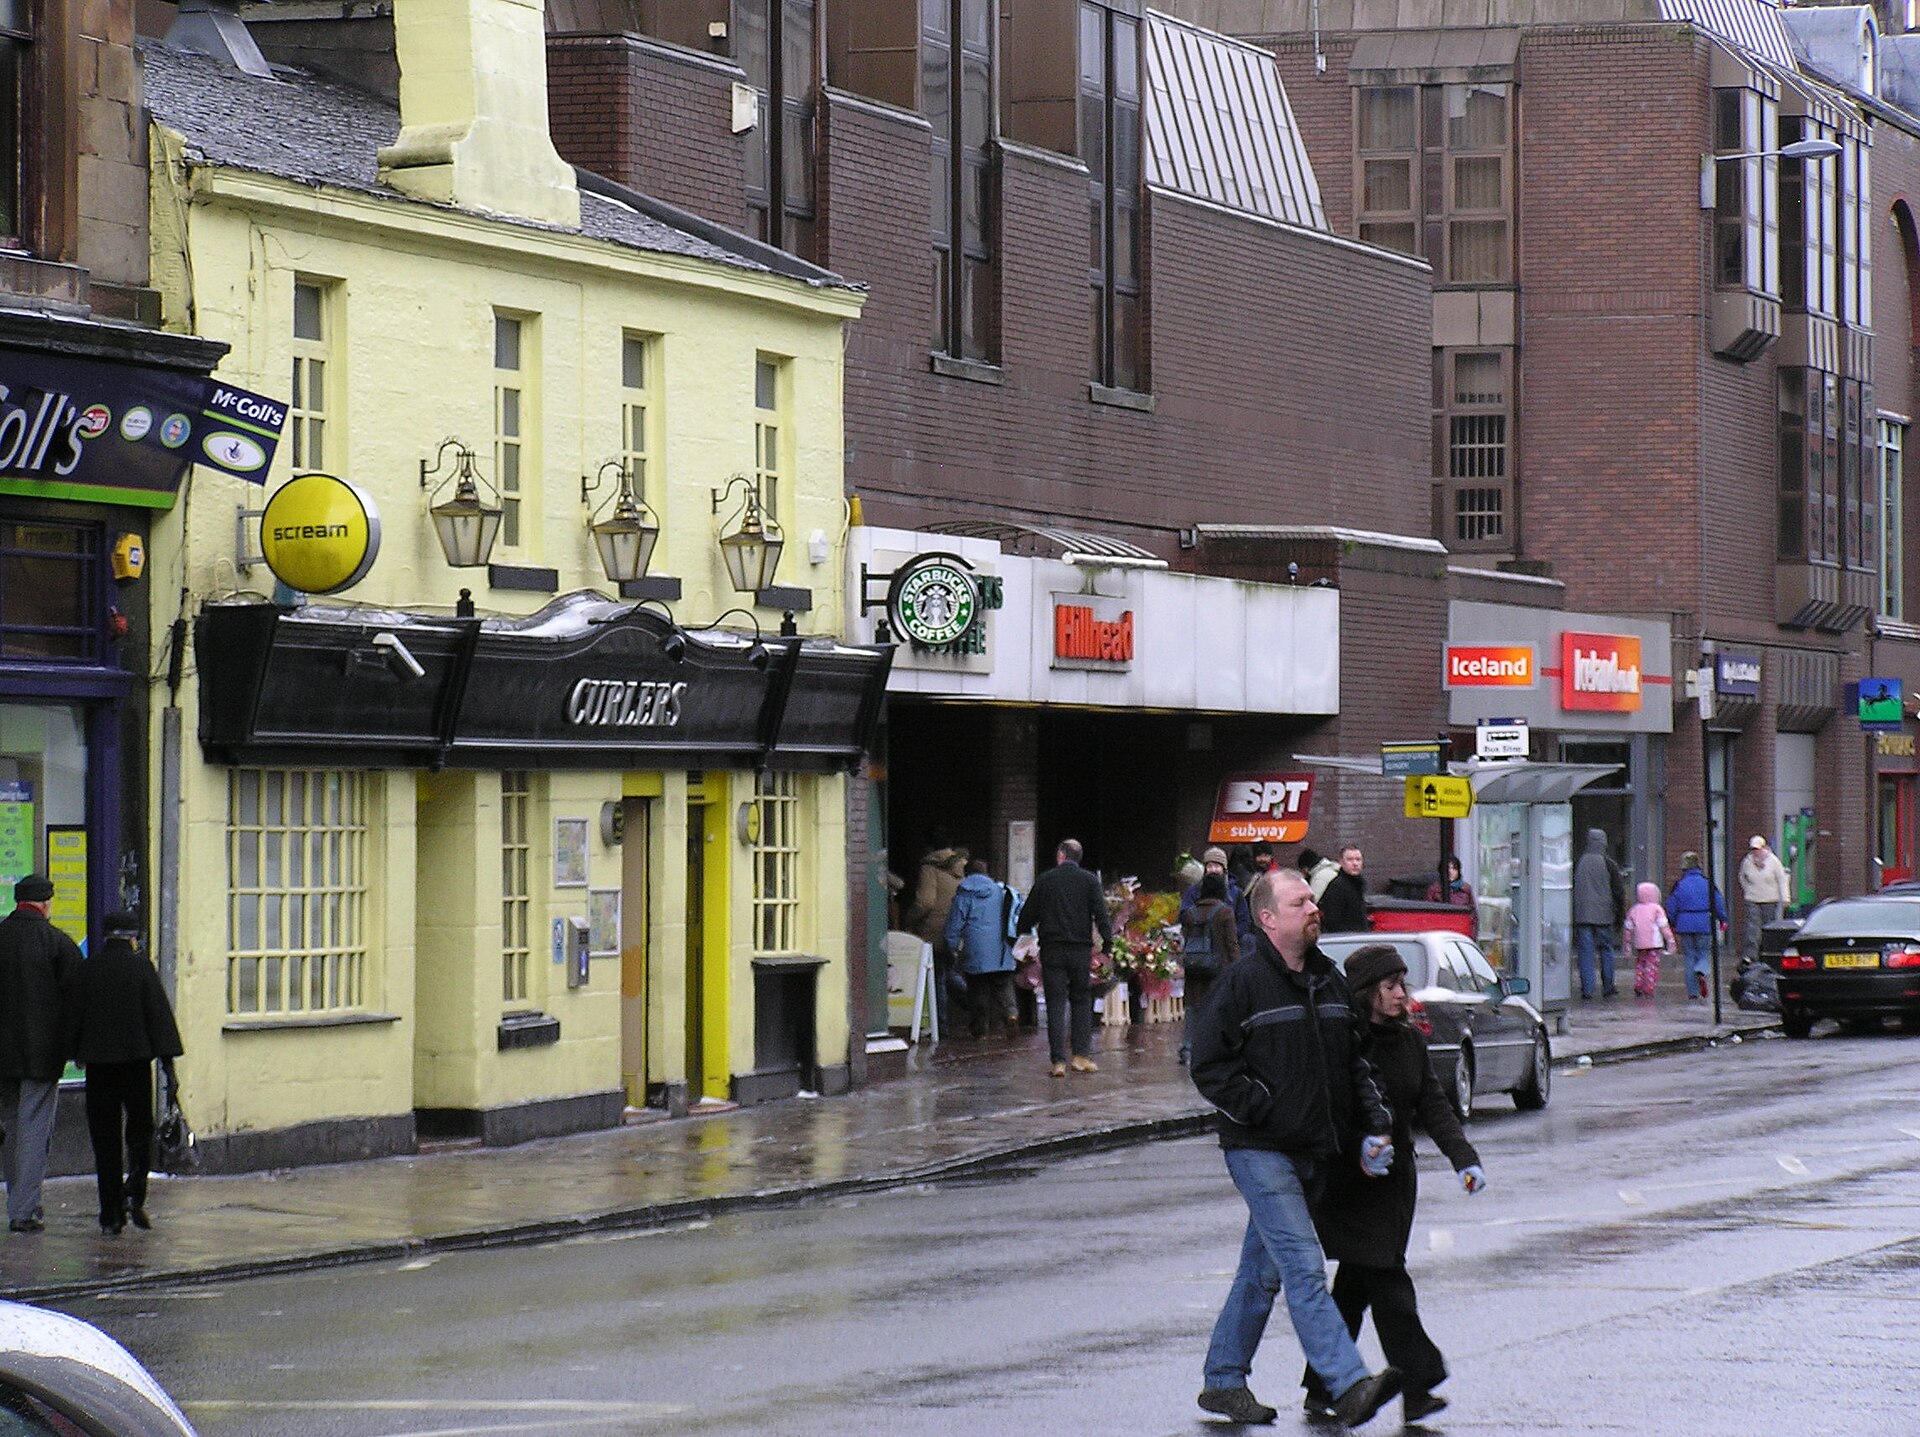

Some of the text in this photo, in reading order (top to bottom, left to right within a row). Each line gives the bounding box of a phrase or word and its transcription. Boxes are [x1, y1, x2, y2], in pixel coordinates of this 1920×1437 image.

[211, 389, 284, 426] McColl's
[273, 523, 348, 541] scream
[903, 570, 970, 604] STARBUCKS
[909, 619, 962, 640] COFFEE
[1452, 657, 1527, 676] Iceland
[567, 678, 688, 727] CURLERS
[1225, 781, 1310, 813] SPT
[1230, 822, 1287, 841] subway
